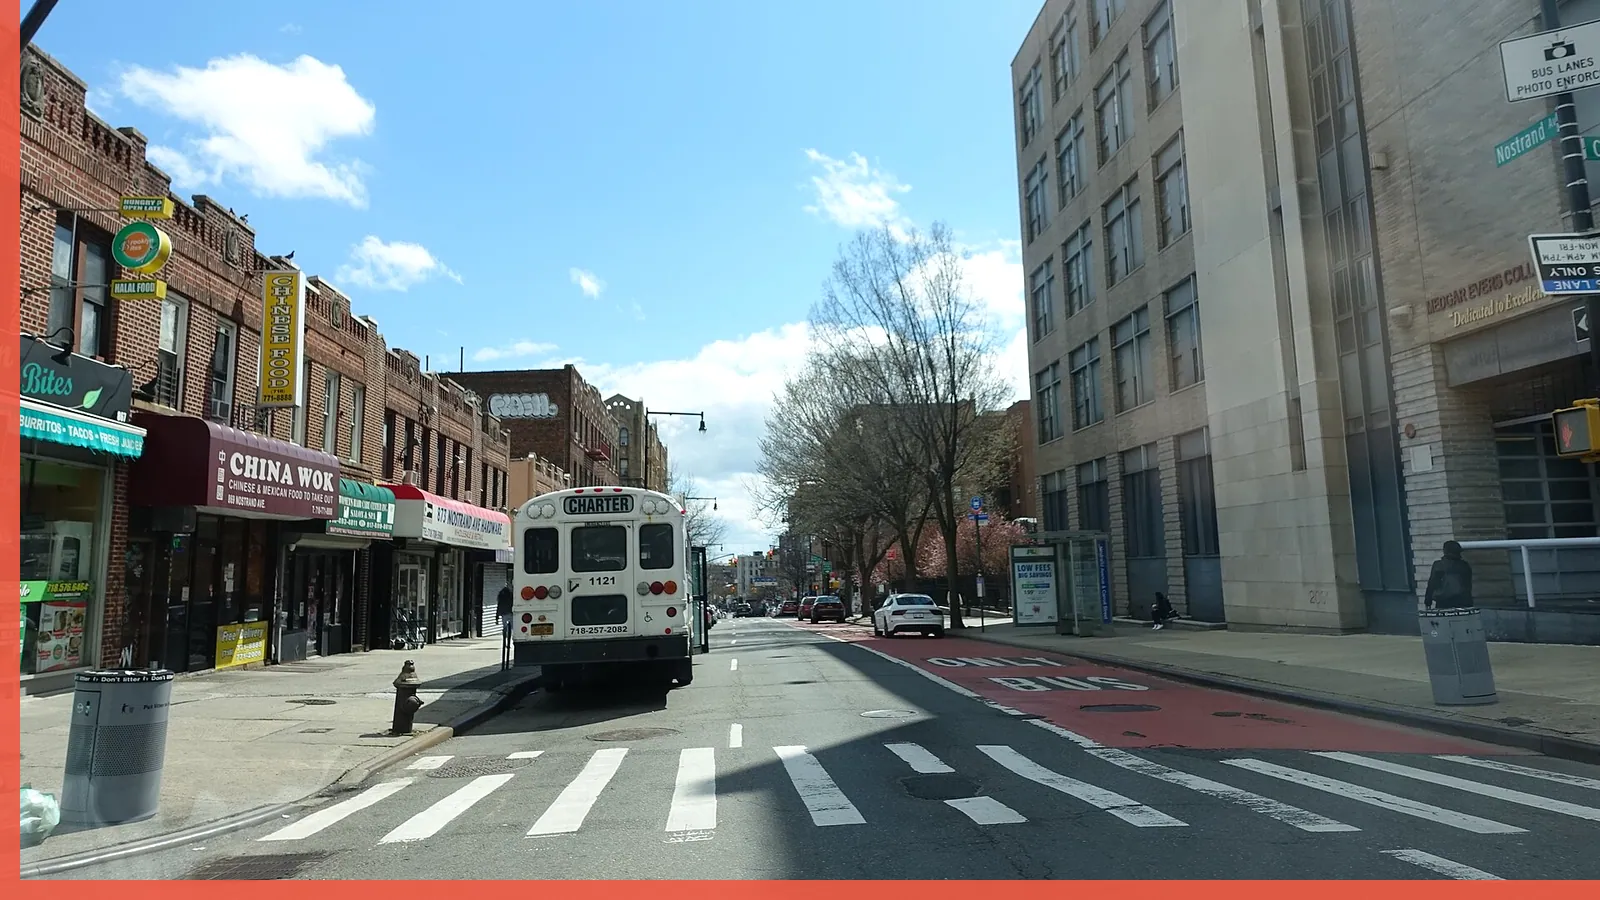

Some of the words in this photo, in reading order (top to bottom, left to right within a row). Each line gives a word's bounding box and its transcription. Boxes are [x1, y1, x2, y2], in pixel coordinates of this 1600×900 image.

[1531, 66, 1554, 79] BUS
[1558, 57, 1594, 74] LANES
[1517, 80, 1552, 95] PHOTO
[1496, 122, 1545, 164] Nostrand
[1559, 242, 1599, 251] MON-FRI
[1542, 253, 1586, 262] 4PM-7PM
[1549, 266, 1587, 277] ONLY
[114, 282, 136, 294] HALAL
[137, 282, 156, 293] FOOD
[1553, 279, 1591, 290] LANE
[1426, 287, 1467, 315] MEDGAR
[1468, 272, 1503, 299] EVERS
[271, 275, 293, 344] CHINESE
[1496, 302, 1505, 313] to
[268, 348, 290, 388] FOOD
[22, 362, 73, 396] Bites
[20, 414, 62, 434] BURRITOS
[68, 425, 94, 440] TACOS
[100, 432, 119, 445] FRESH
[230, 452, 293, 486] CHINA
[298, 466, 334, 492] WOK
[228, 479, 256, 494] CHINESE
[256, 484, 262, 494] &
[262, 484, 288, 498] MEXICAN
[288, 488, 303, 500] FOOD
[303, 491, 311, 501] TO
[311, 493, 324, 503] TAKE
[324, 495, 334, 504] OUT
[236, 495, 257, 508] NOSTRAND
[569, 497, 629, 512] CHARTER
[437, 507, 447, 523] 873
[447, 509, 472, 530] NOSTRAND
[472, 517, 481, 532] AVE
[481, 519, 503, 536] HARDWARE
[1017, 564, 1033, 572] LOW
[589, 577, 616, 586] 1121
[570, 625, 628, 635] 718-257-2082
[926, 656, 1065, 667] ONLY
[987, 676, 1150, 691] BUS
